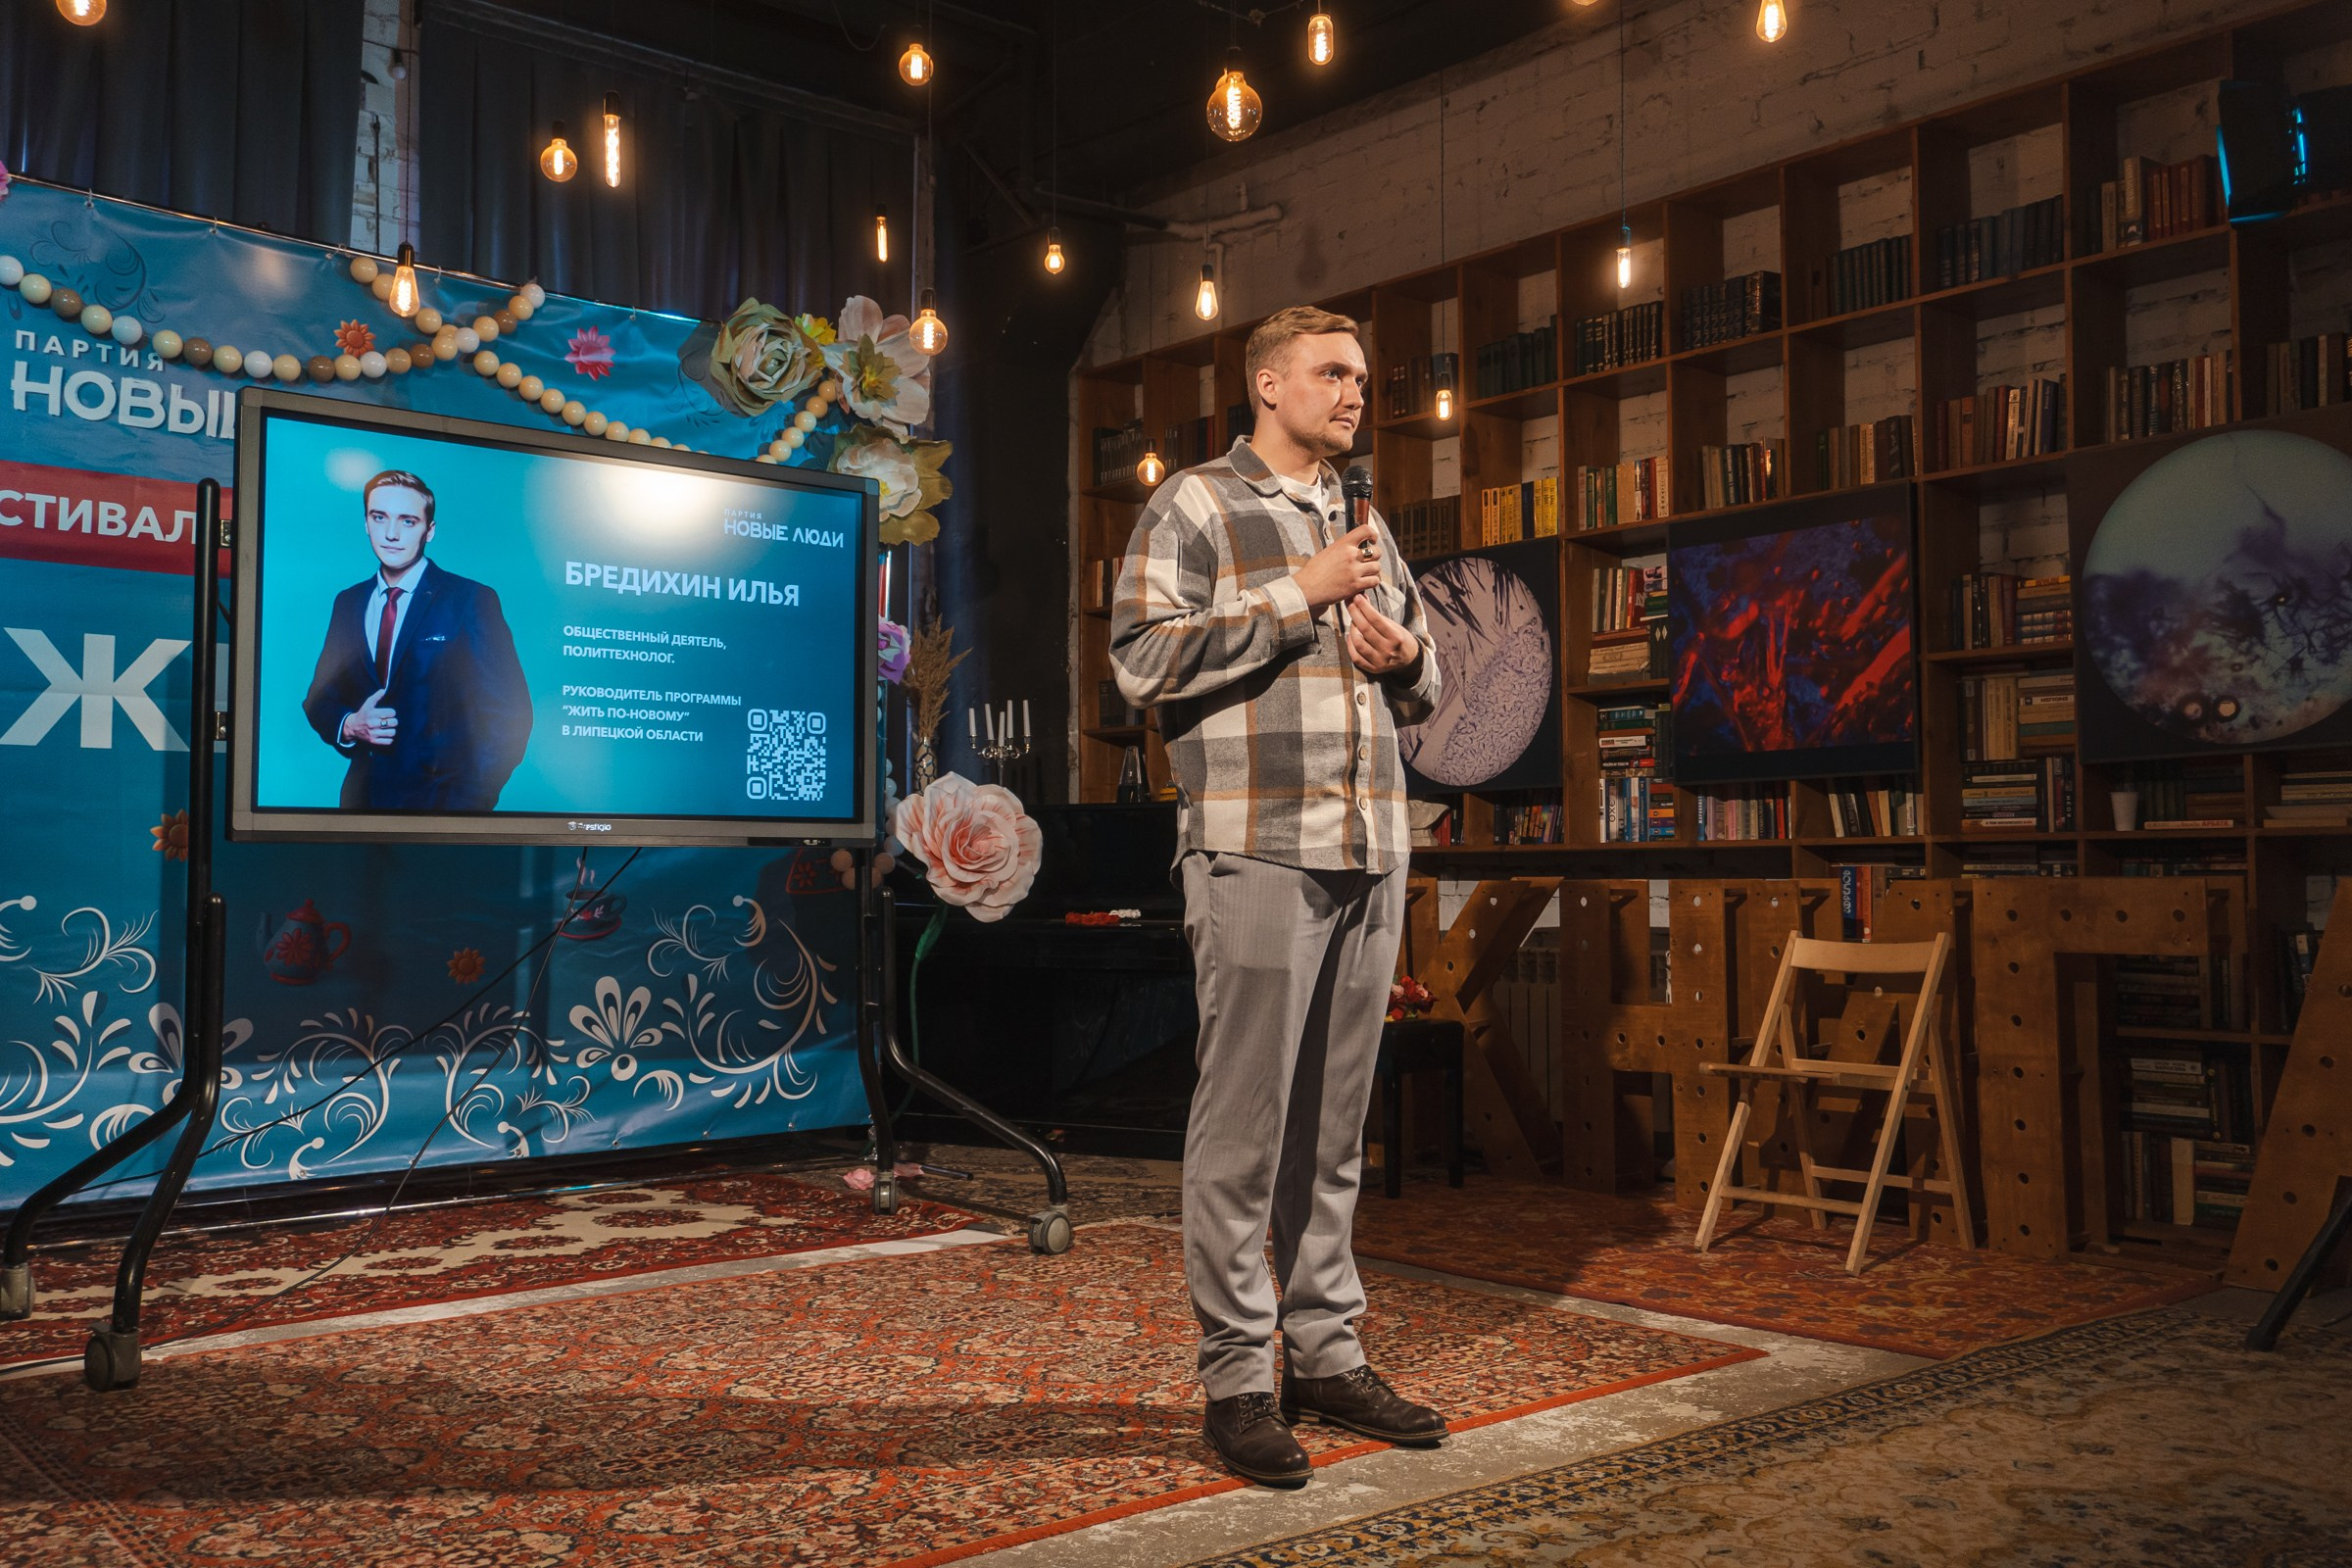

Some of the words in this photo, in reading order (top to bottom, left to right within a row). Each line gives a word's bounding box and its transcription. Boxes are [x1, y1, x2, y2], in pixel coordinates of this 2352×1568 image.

[15, 329, 165, 372] ПАРТИЯ
[11, 361, 235, 440] НОВЫ
[724, 509, 762, 520] ПАРТИЯ
[723, 518, 789, 542] НОВЫЕ
[792, 527, 844, 548] ЛЮДИ
[564, 561, 720, 600] БРЕДИХИН
[728, 580, 801, 608] ИЛЬЯ
[563, 624, 669, 644] ОБЩЕСТВЕННЫЙ
[670, 634, 727, 651] ДЕЯТЕЛЬ,
[563, 645, 675, 663] ПОЛИТТЕХНОЛОГ.
[562, 685, 662, 702] РУКОВОДИТЕЛЬ
[664, 691, 742, 707] ПРОГРАММЫ
[562, 724, 570, 736] В
[571, 725, 644, 740] ЛИПЕЦКОЙ
[646, 730, 704, 742] ОБЛАСТИ
